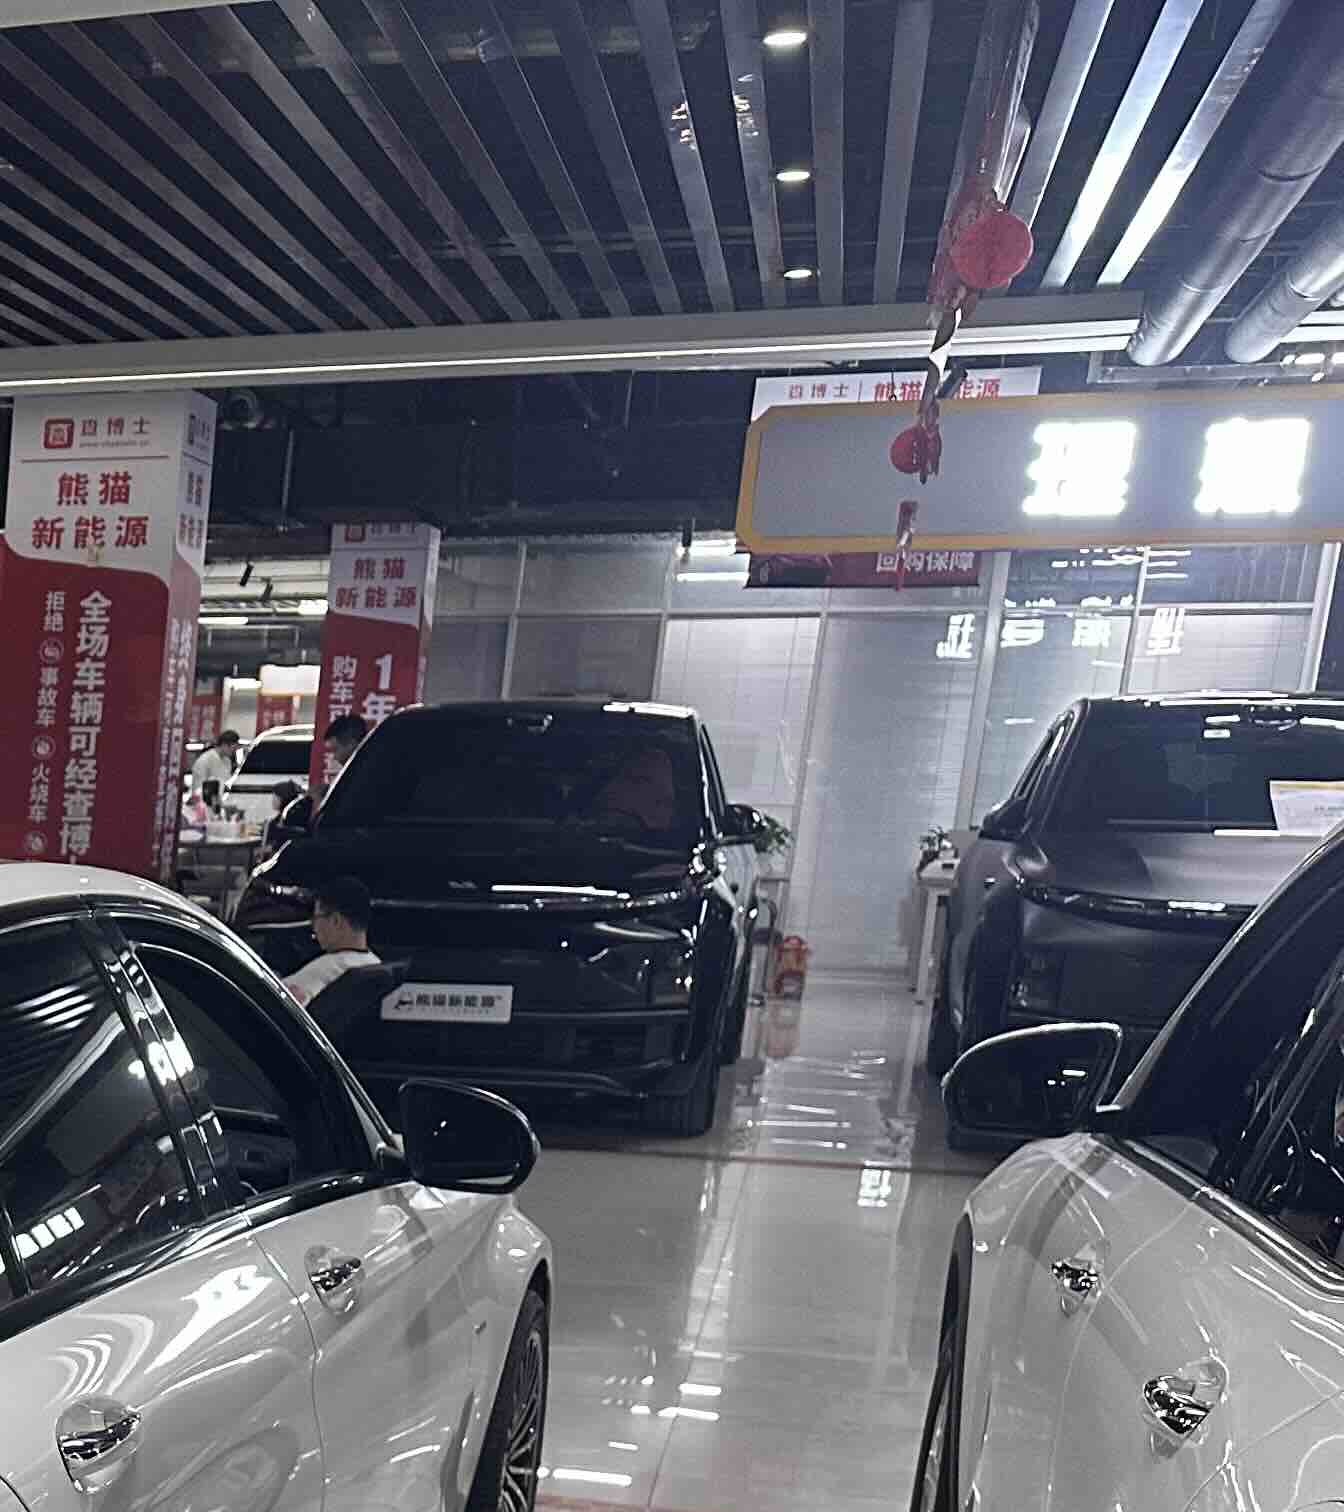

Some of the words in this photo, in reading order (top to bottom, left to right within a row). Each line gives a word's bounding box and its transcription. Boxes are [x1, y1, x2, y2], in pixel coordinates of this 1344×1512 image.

[873, 377, 1002, 400] 熊猫能源
[56, 471, 132, 505] 熊猫
[31, 515, 150, 549] 新能源
[353, 558, 408, 579] 熊猫
[44, 591, 65, 633] 拒绝
[335, 586, 417, 609] 新能源
[60, 590, 112, 864] 全场车辆可经查博
